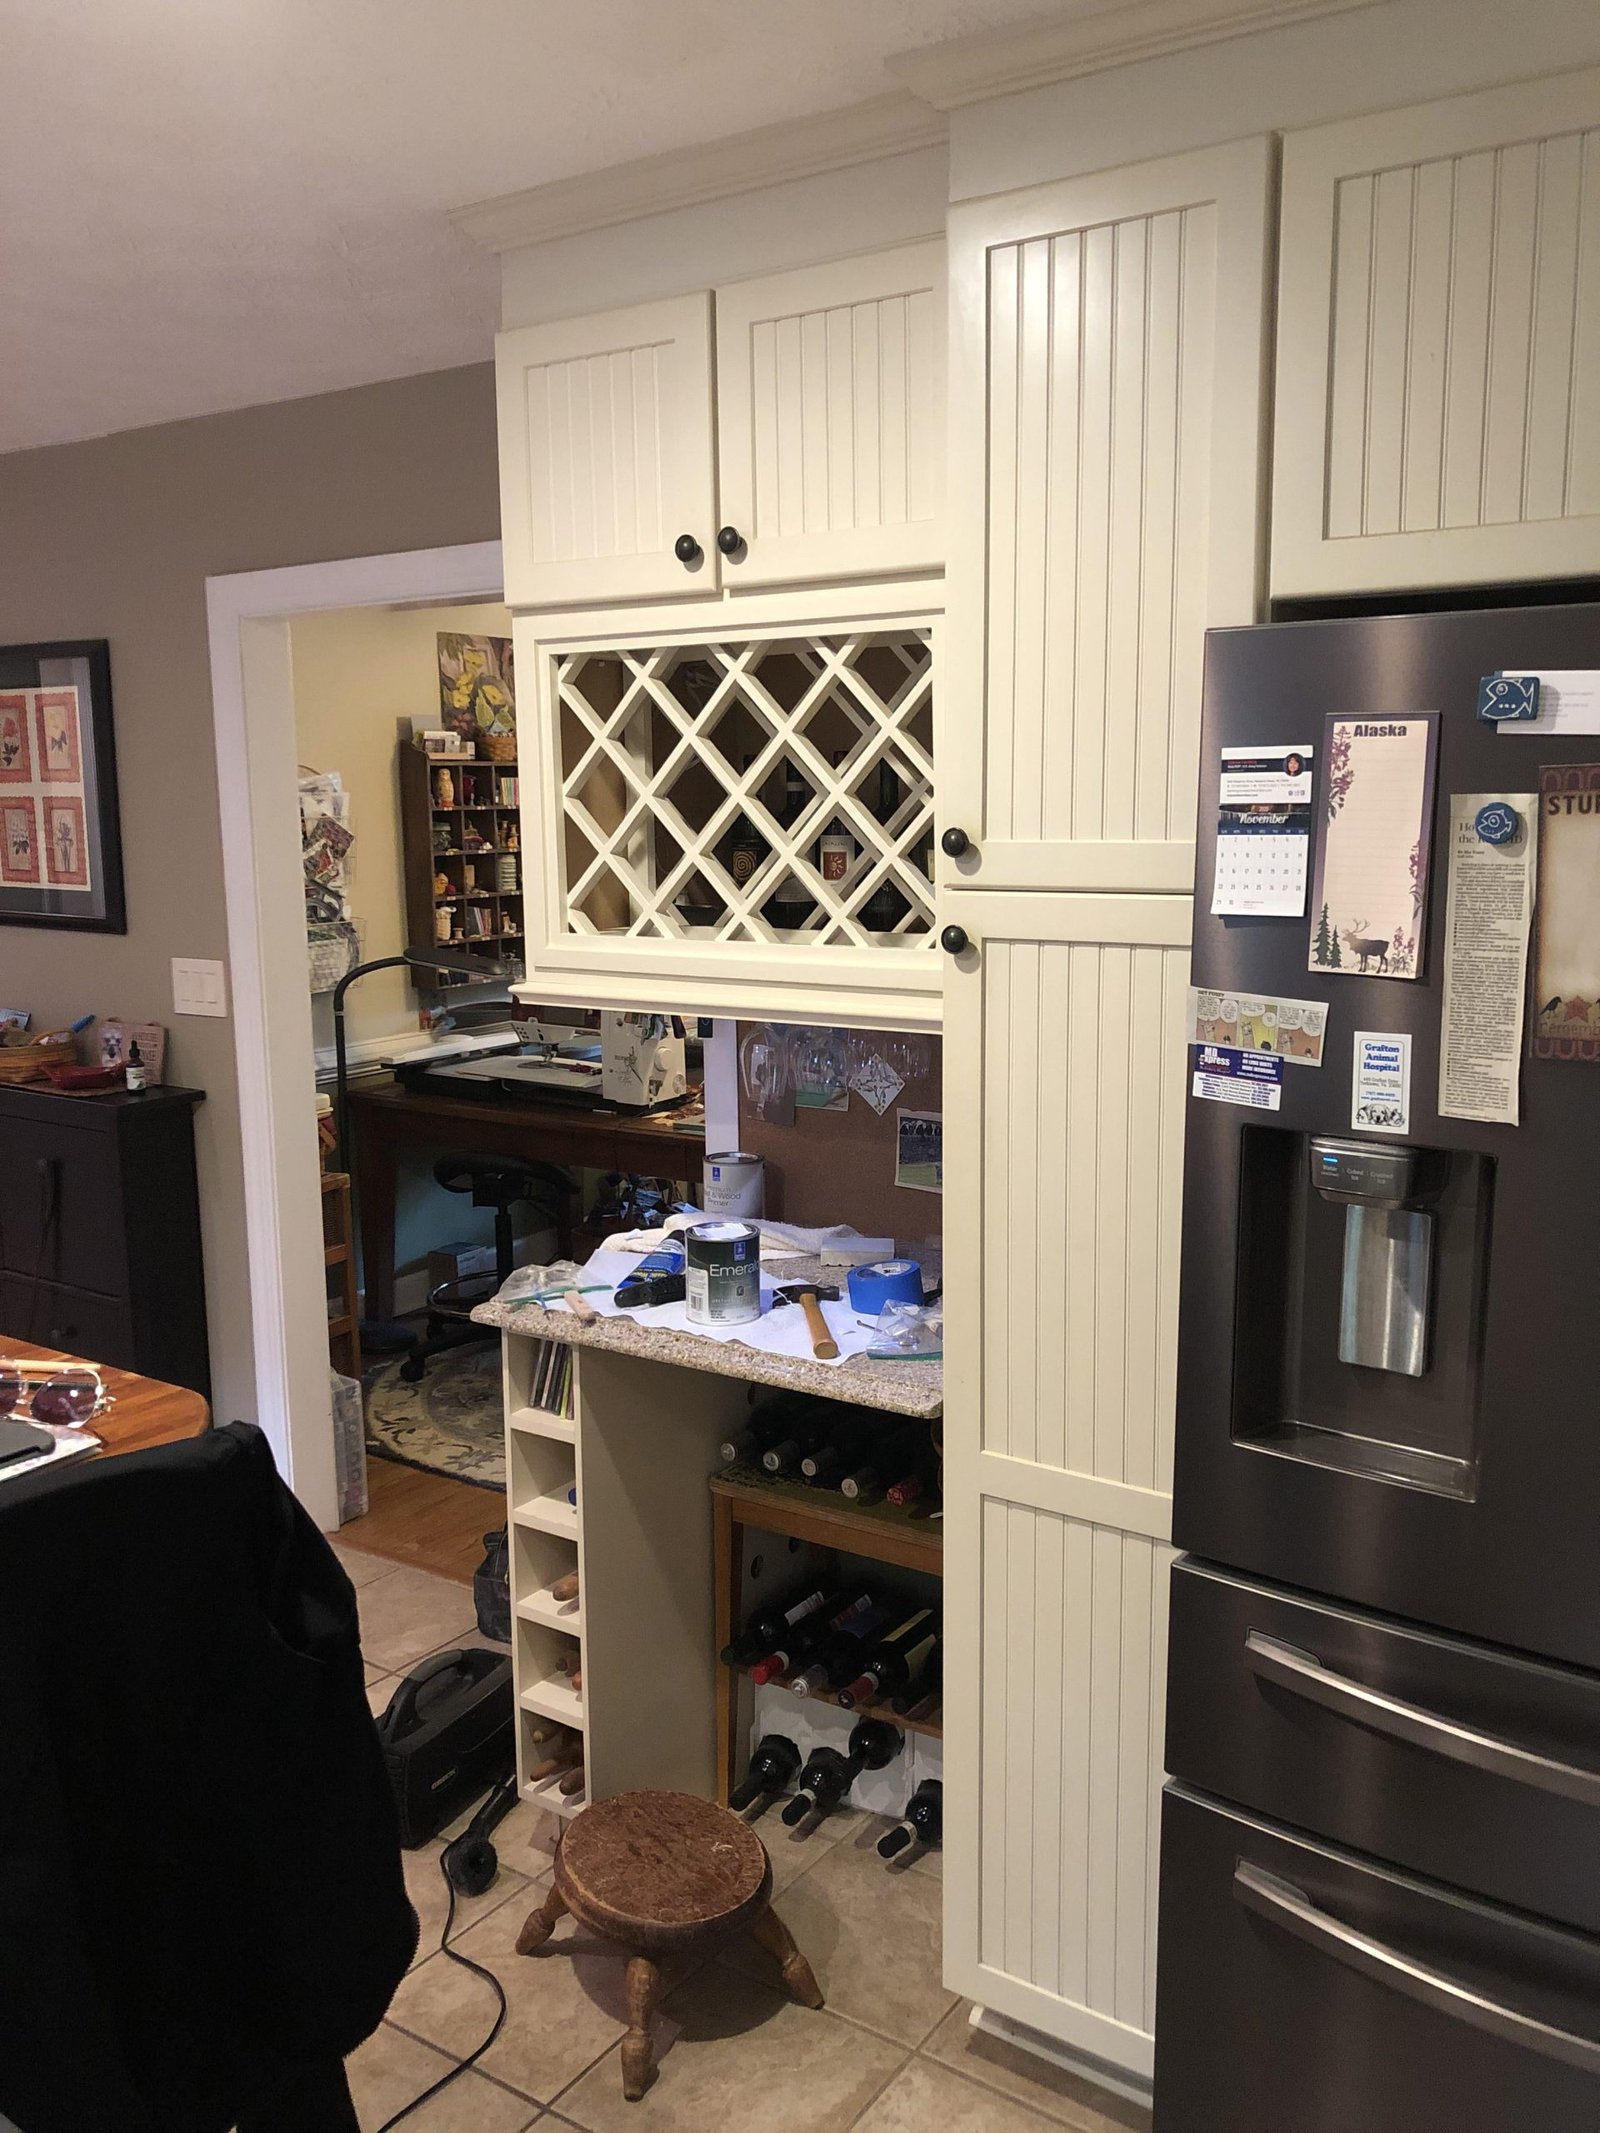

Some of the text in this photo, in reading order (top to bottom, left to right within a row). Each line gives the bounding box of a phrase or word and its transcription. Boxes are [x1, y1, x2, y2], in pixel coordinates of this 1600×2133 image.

[1353, 724, 1407, 737] Alaska
[1238, 813, 1289, 824] November
[1460, 822, 1475, 832] Ho
[1458, 834, 1475, 843] the
[1204, 1046, 1218, 1057] MD
[1365, 1044, 1400, 1053] Grafton
[1199, 1054, 1230, 1066] Express
[1366, 1053, 1398, 1062] Animal
[1364, 1062, 1400, 1072] Hospital
